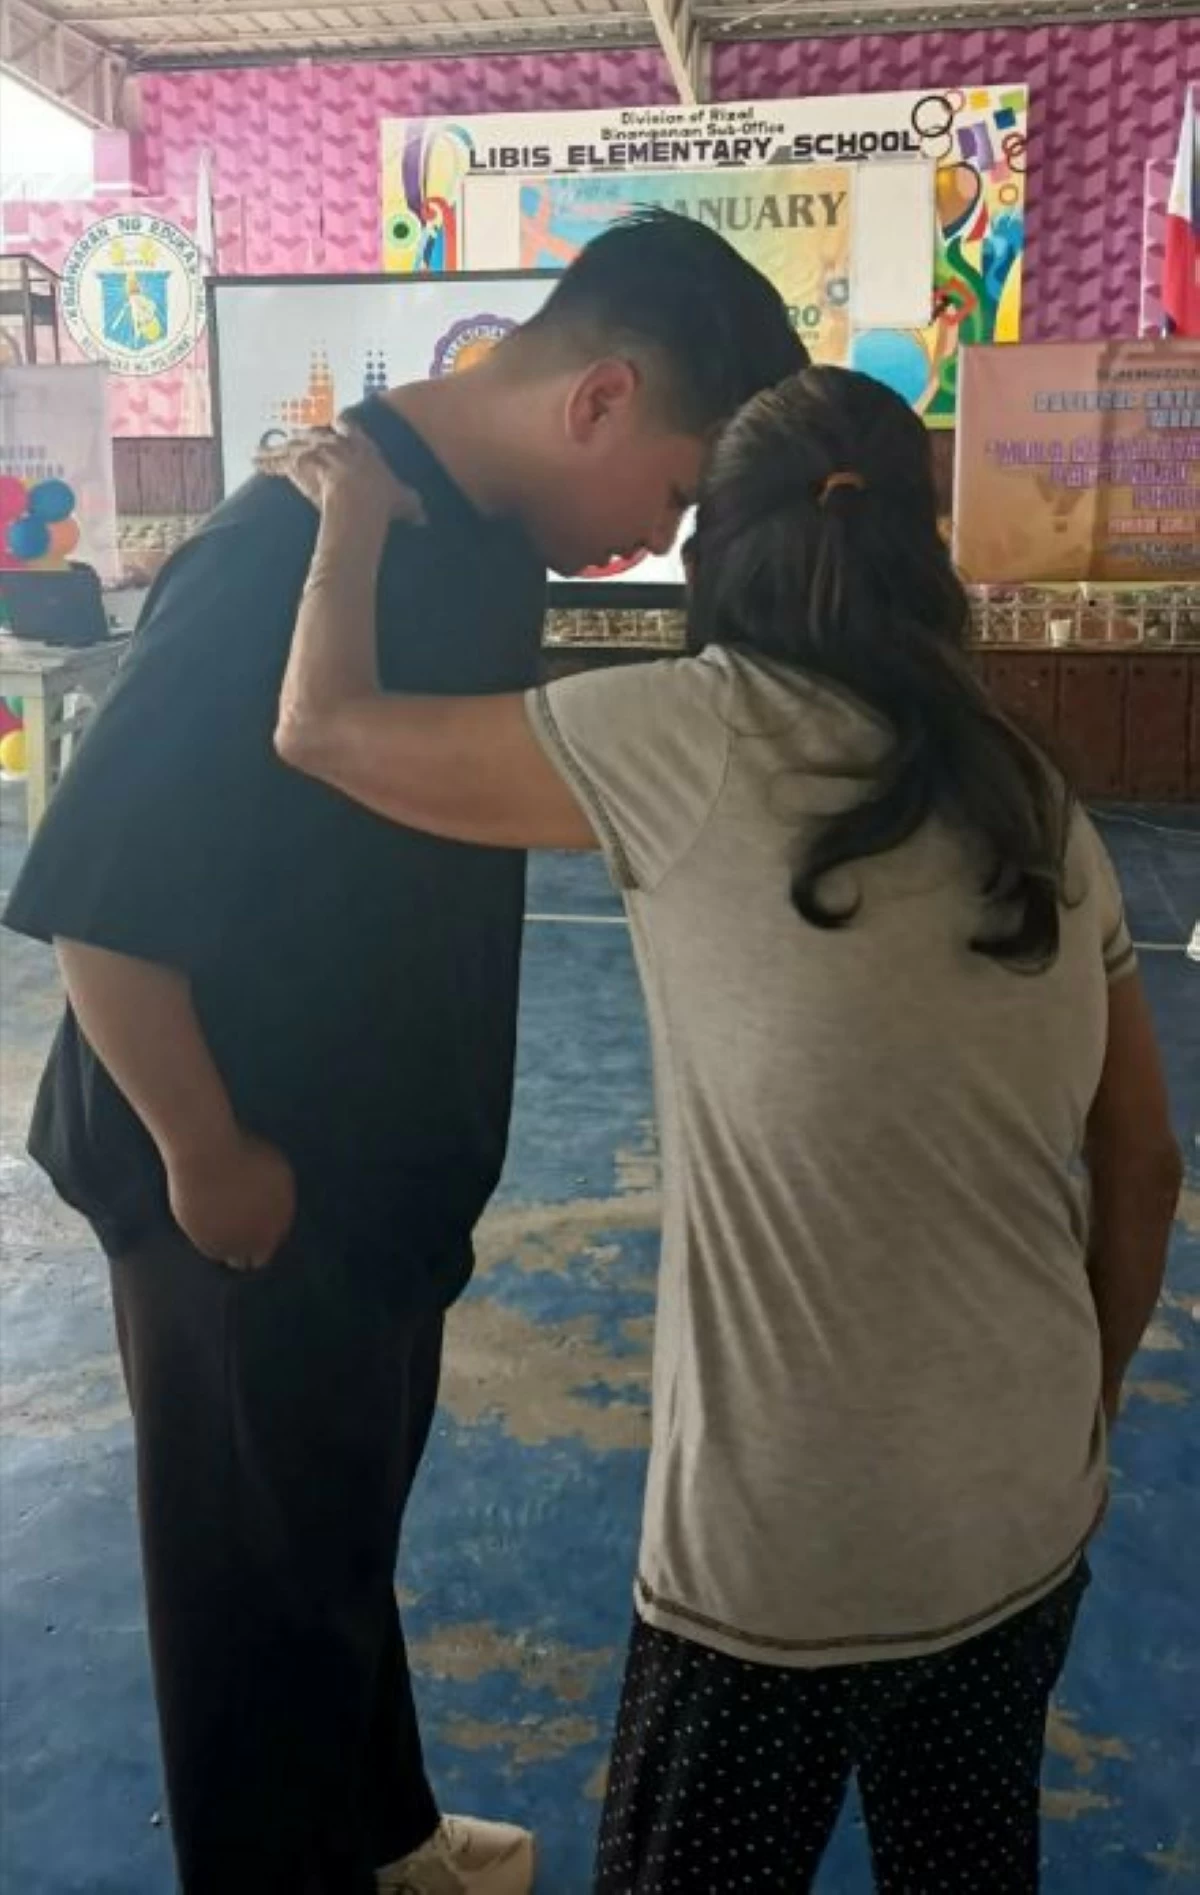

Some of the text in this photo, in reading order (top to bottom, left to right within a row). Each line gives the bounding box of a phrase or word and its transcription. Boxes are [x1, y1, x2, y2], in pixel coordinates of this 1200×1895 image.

[621, 106, 755, 125] Division of Rizal
[469, 131, 921, 169] LIBIS ELEMENTARY SCHOOL
[651, 191, 847, 231] ANUARY
